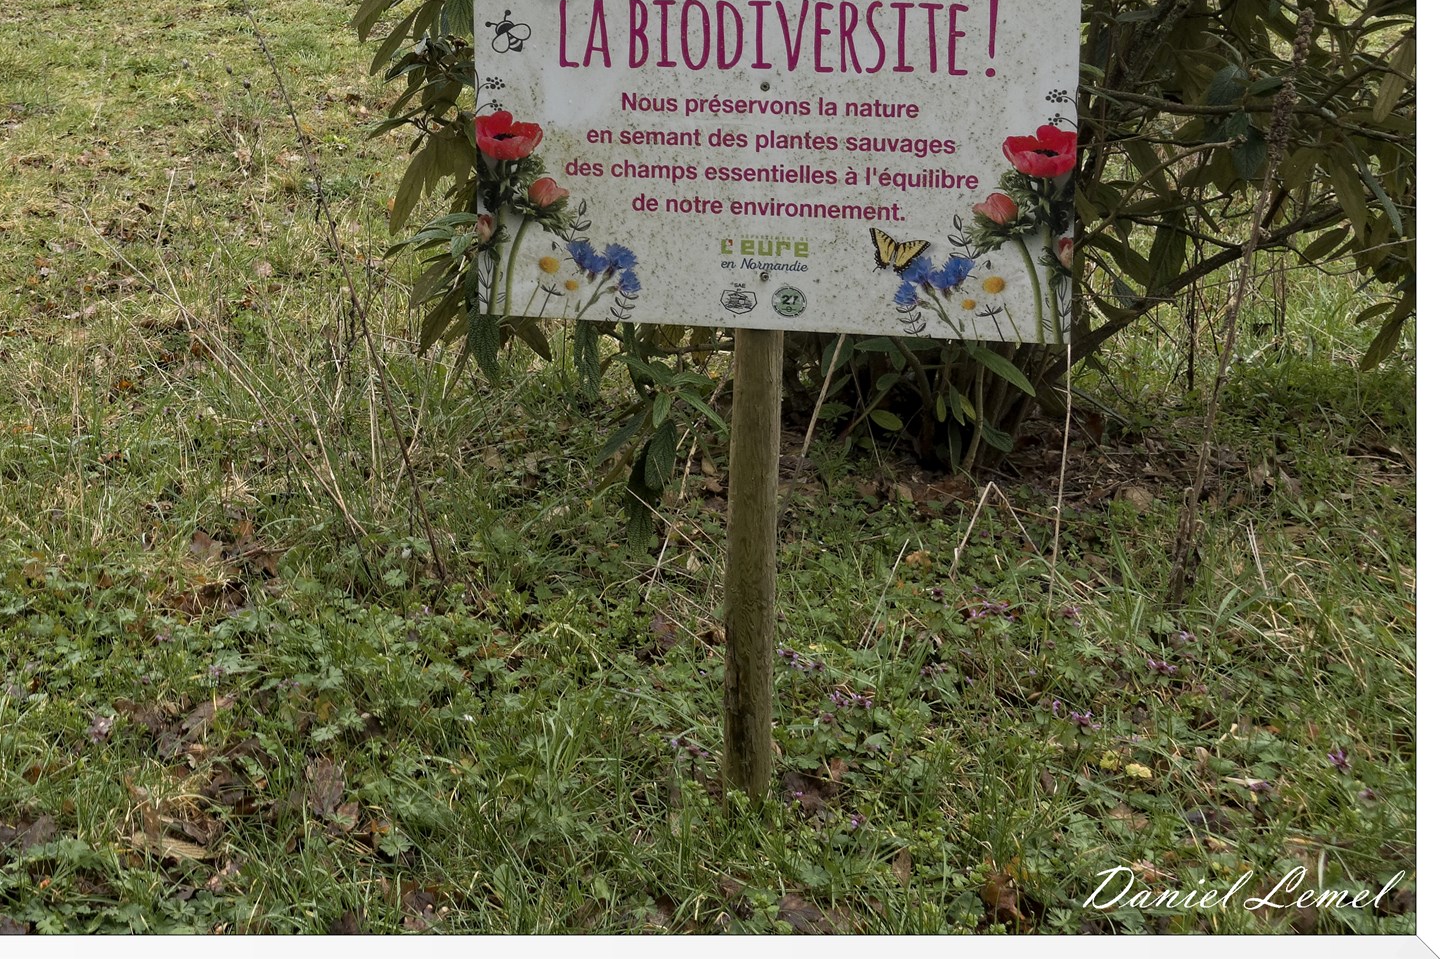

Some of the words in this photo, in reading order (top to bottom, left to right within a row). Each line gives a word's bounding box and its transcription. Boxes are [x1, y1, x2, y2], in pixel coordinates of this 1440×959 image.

[621, 92, 678, 113] Nous
[685, 93, 811, 118] préservons
[818, 97, 838, 117] la
[845, 100, 920, 119] nature
[586, 129, 613, 144] en
[619, 128, 700, 146] semant
[708, 128, 748, 148] des
[755, 129, 839, 154] plantes
[846, 136, 956, 159] sauvages
[565, 158, 603, 177] des
[611, 159, 698, 184] champs
[704, 165, 838, 186] essentielles
[844, 167, 858, 186] à
[865, 166, 979, 192] l'équilibre
[632, 193, 659, 212] de
[666, 196, 723, 215] notre
[730, 200, 906, 222] environnement.
[720, 259, 736, 269] en
[739, 257, 809, 272] Normandie
